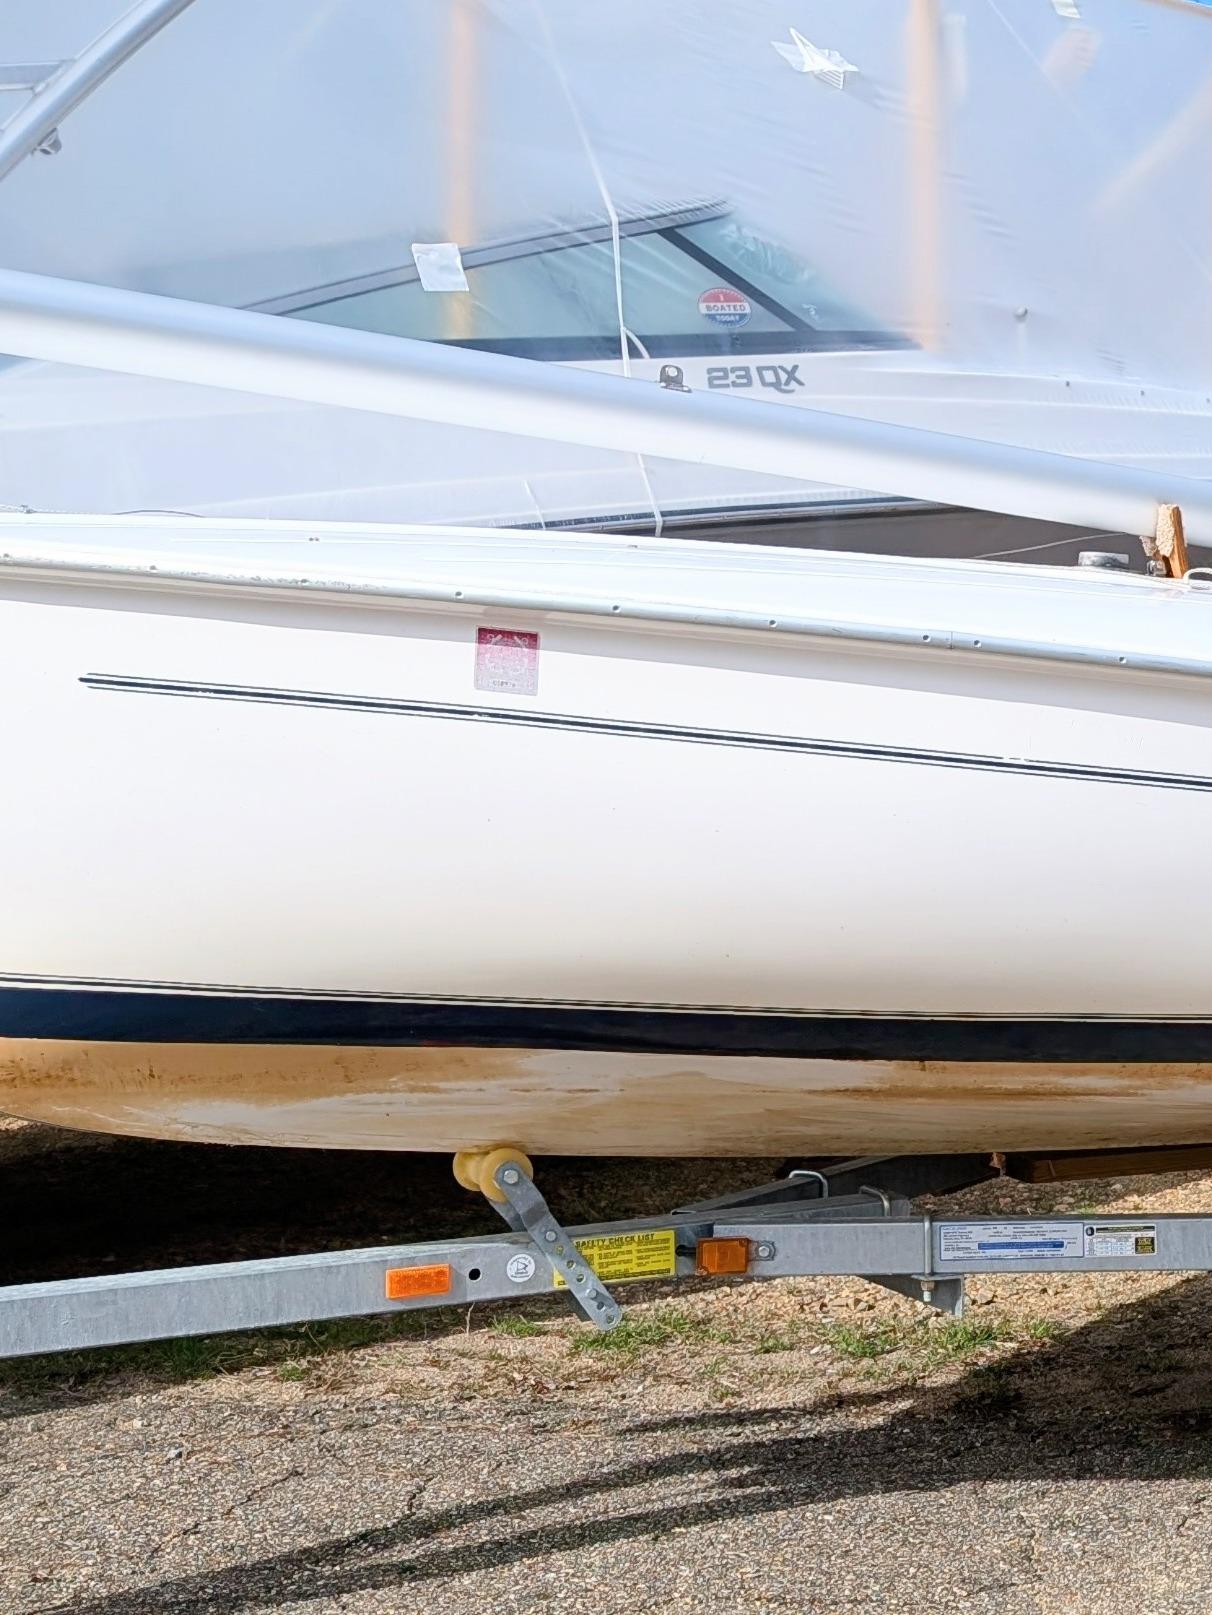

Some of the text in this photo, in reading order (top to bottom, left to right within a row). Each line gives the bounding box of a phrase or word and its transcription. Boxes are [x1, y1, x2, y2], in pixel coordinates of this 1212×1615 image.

[705, 304, 746, 312] BOATED
[706, 364, 806, 394] 23 QX
[609, 1234, 635, 1244] CHECK
[637, 1233, 655, 1241] LIST
